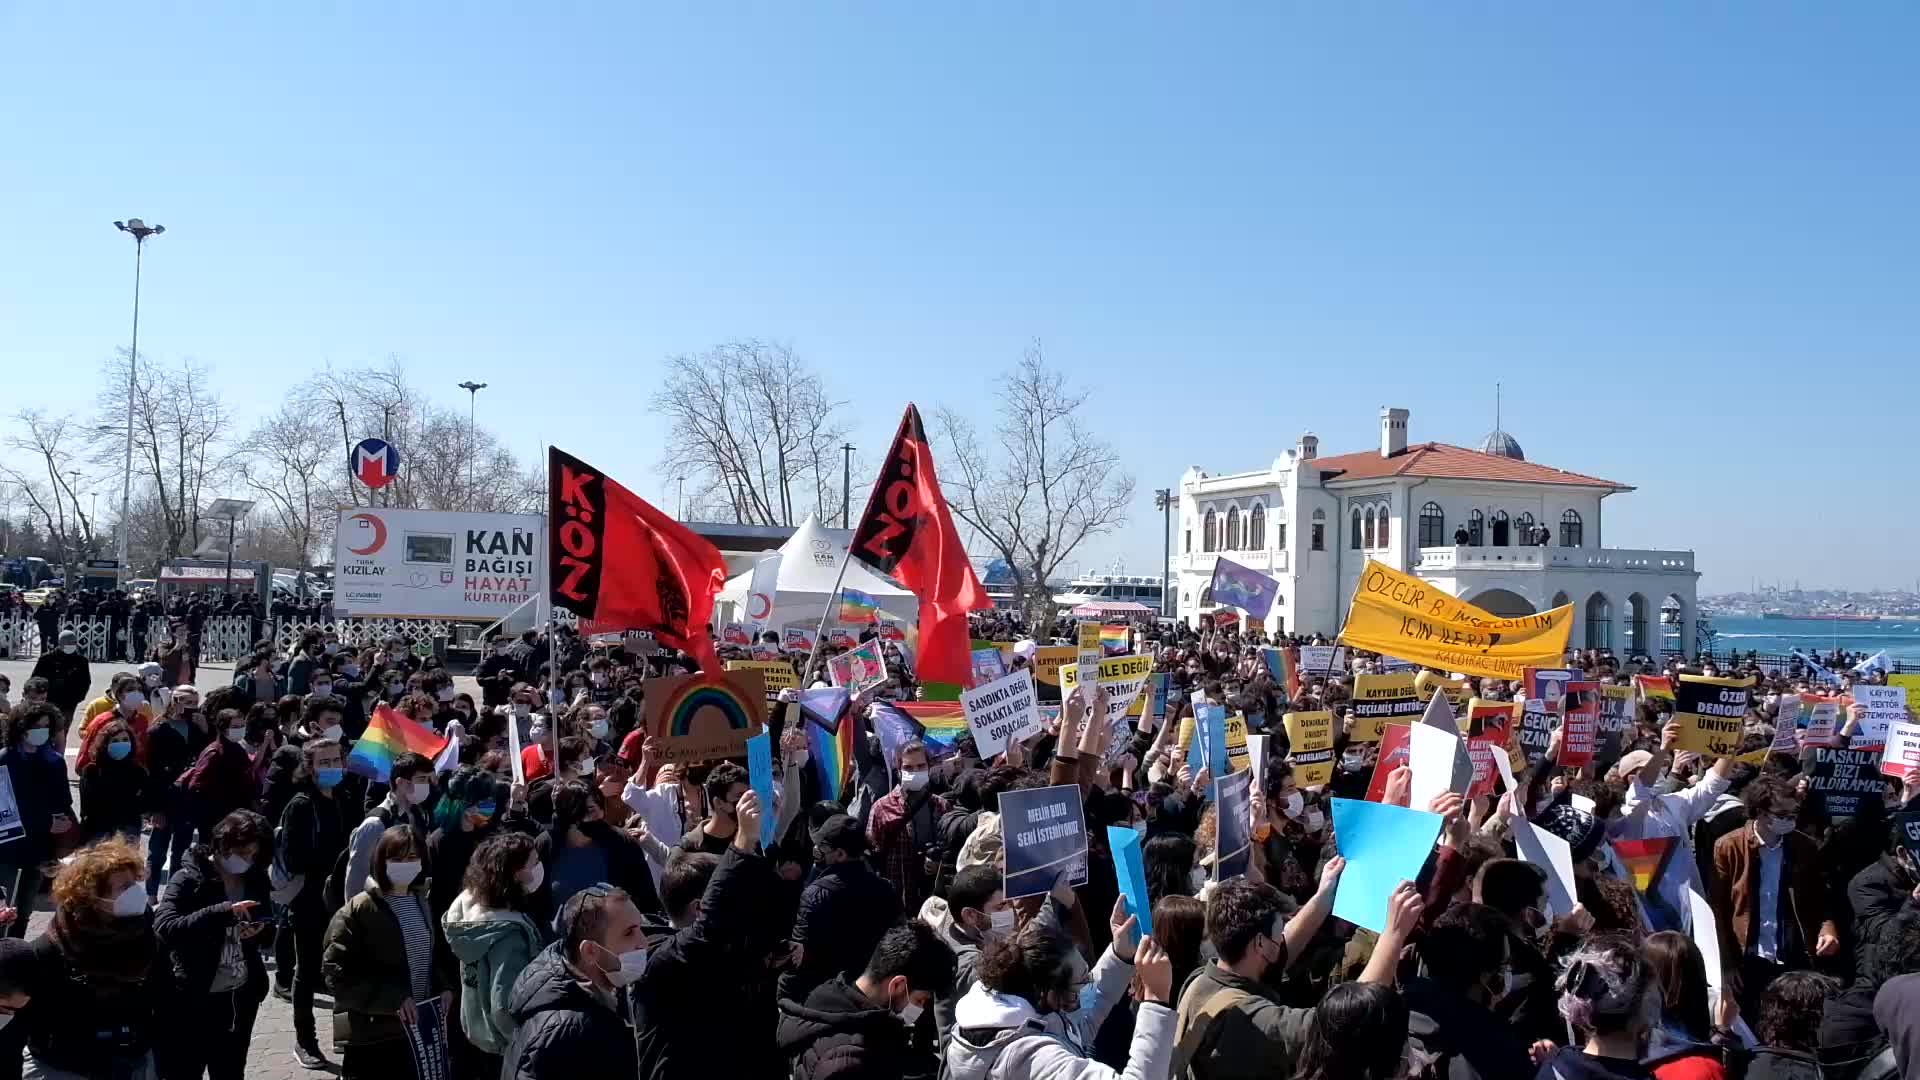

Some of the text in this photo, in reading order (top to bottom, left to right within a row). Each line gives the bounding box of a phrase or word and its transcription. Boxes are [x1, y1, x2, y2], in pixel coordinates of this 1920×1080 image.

[466, 529, 533, 556] KAN
[557, 463, 596, 602] KÖZ
[343, 565, 385, 577] KIZILAY
[465, 557, 532, 577] BAĞIŞI
[464, 577, 532, 592] HAYAT
[1366, 569, 1425, 609] ÖZGÜR
[968, 687, 1010, 713] SANDIKTA
[1365, 687, 1399, 699] KAYYUM
[974, 704, 1014, 729] SOKAKTA
[1355, 702, 1393, 717] SEÇİLMİŞ
[1016, 827, 1038, 848] SENİ
